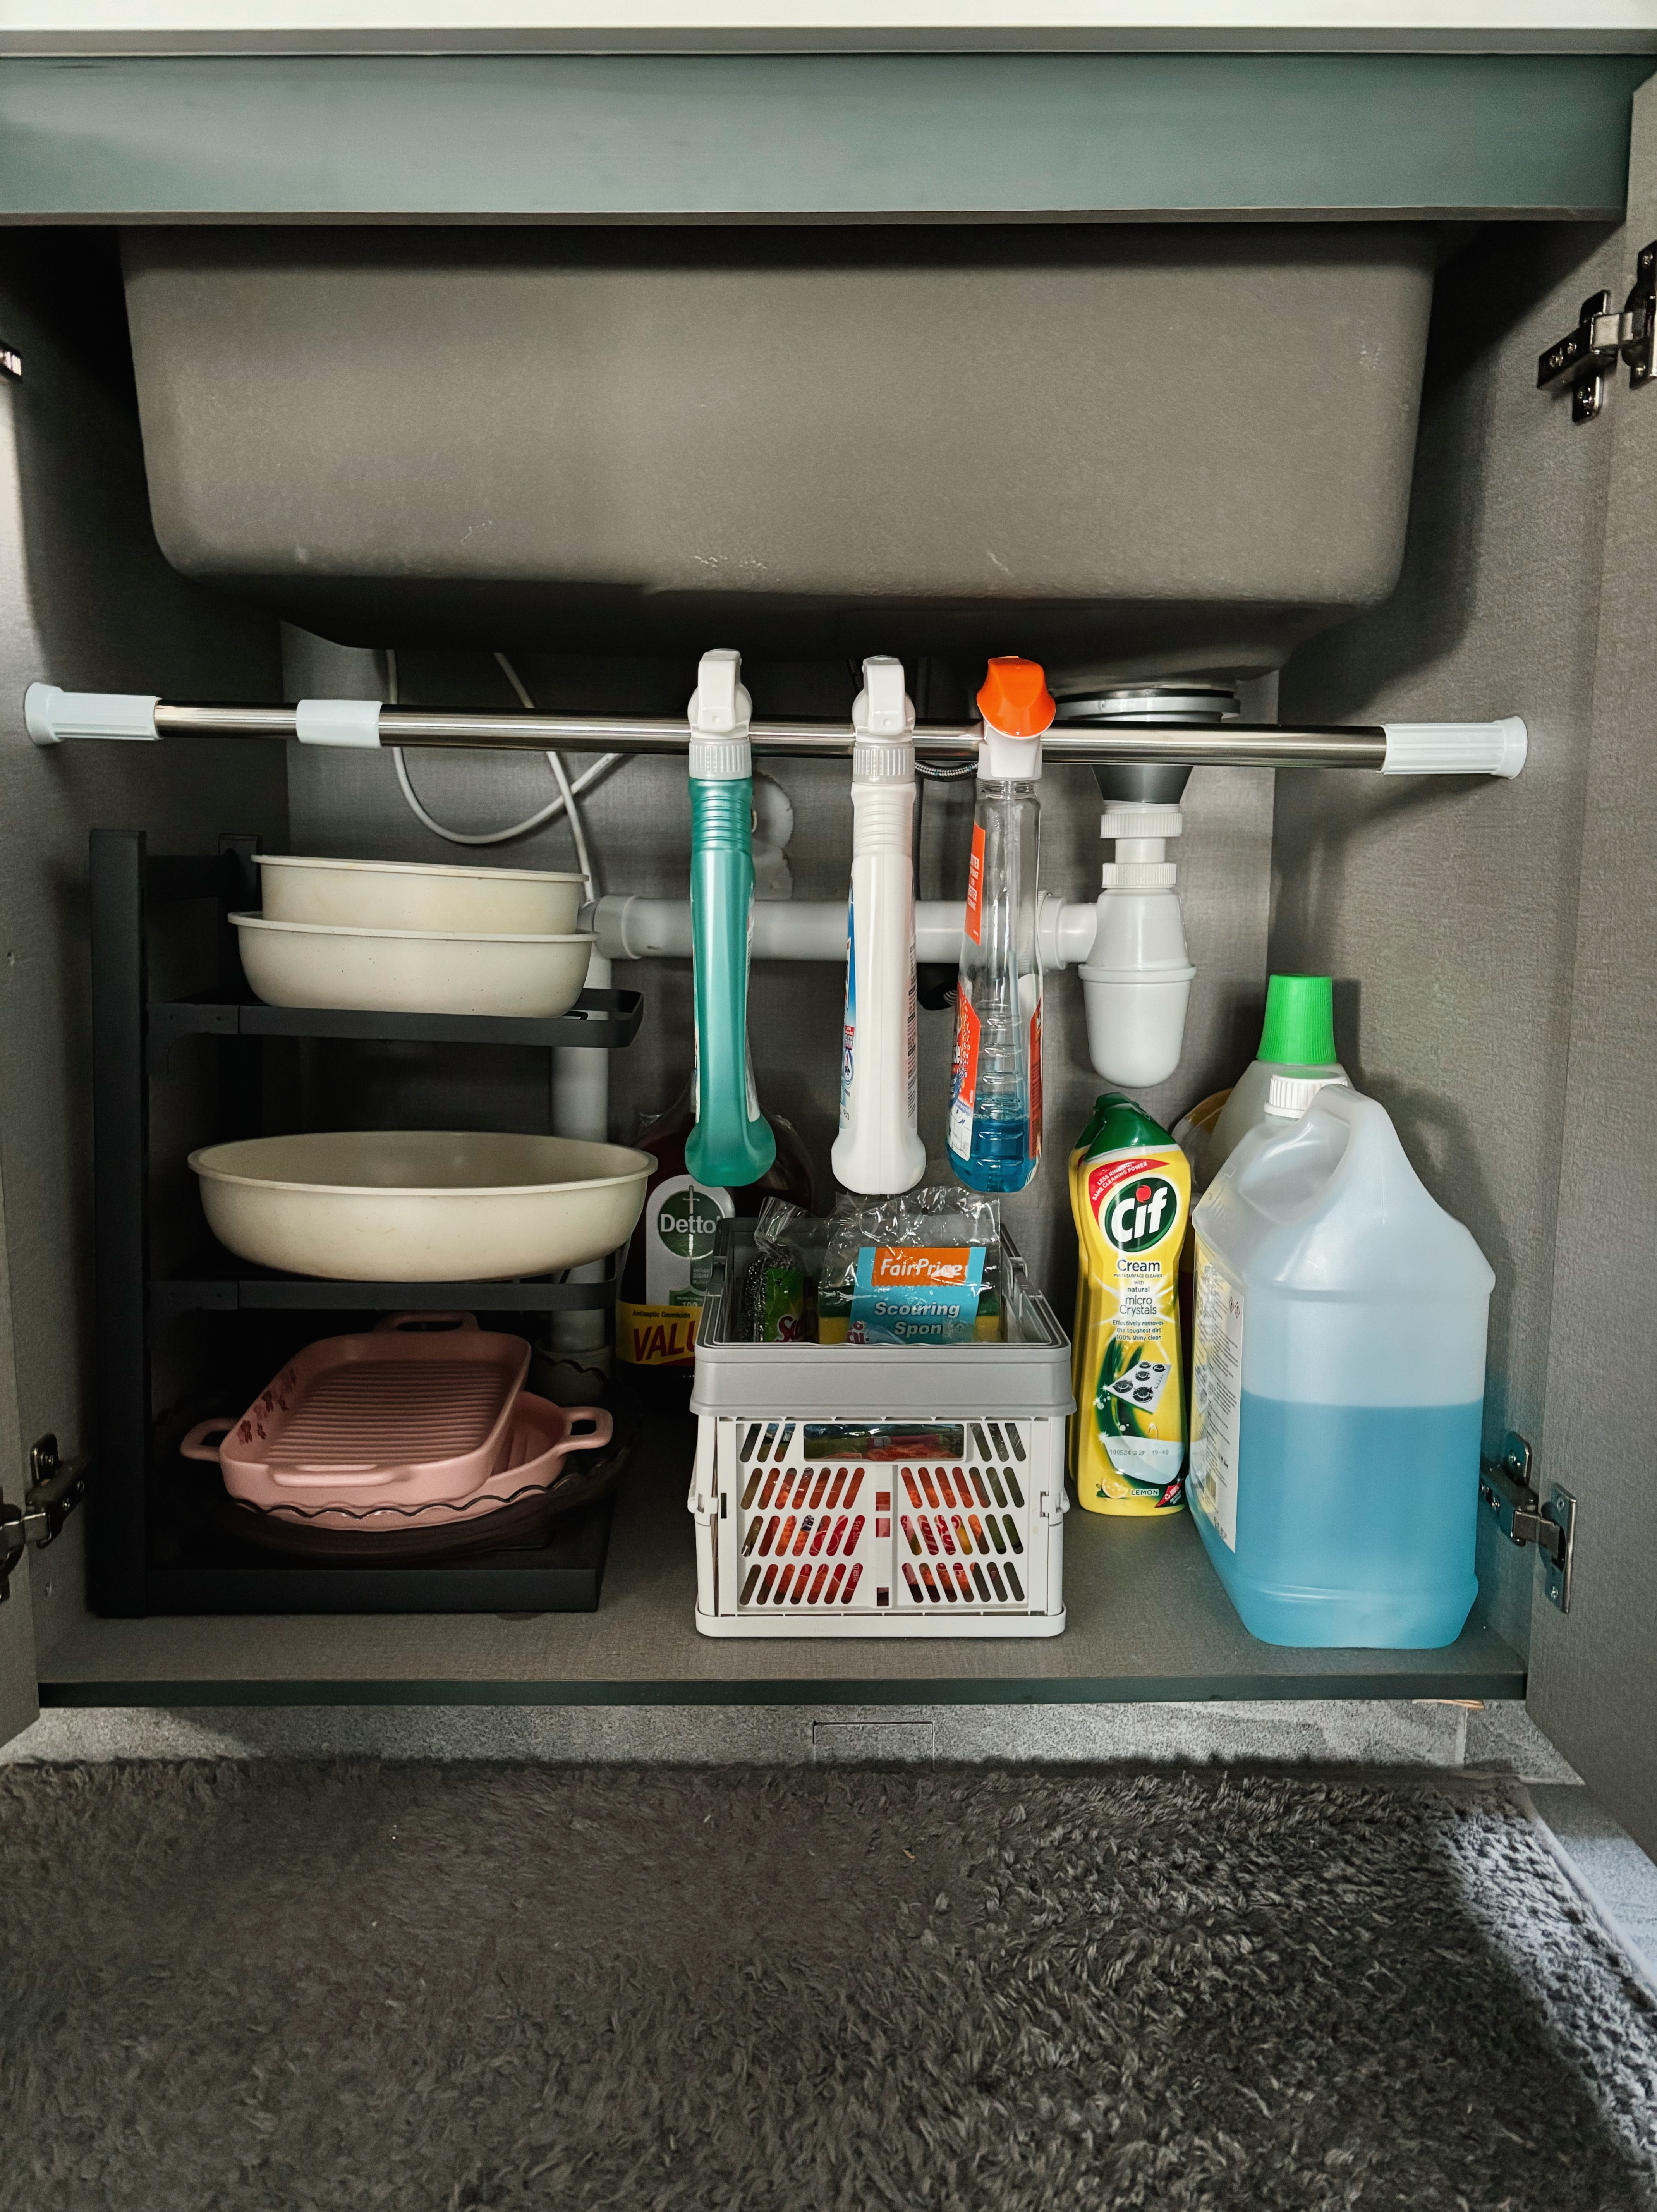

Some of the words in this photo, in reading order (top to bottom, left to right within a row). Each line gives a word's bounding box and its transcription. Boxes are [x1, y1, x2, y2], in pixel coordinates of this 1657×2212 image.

[1092, 1187, 1104, 1201] SAME
[1102, 1170, 1127, 1188] CLEANING
[1127, 1161, 1148, 1173] POWER
[1097, 1174, 1109, 1185] LESS
[1111, 1185, 1168, 1243] Cif
[880, 1258, 962, 1276] FairPrice
[1117, 1259, 1160, 1272] Cream
[1125, 1295, 1152, 1305] micro
[633, 1310, 660, 1319] Antiseptic
[874, 1302, 961, 1319] Scouring
[1119, 1305, 1157, 1317] Crystals
